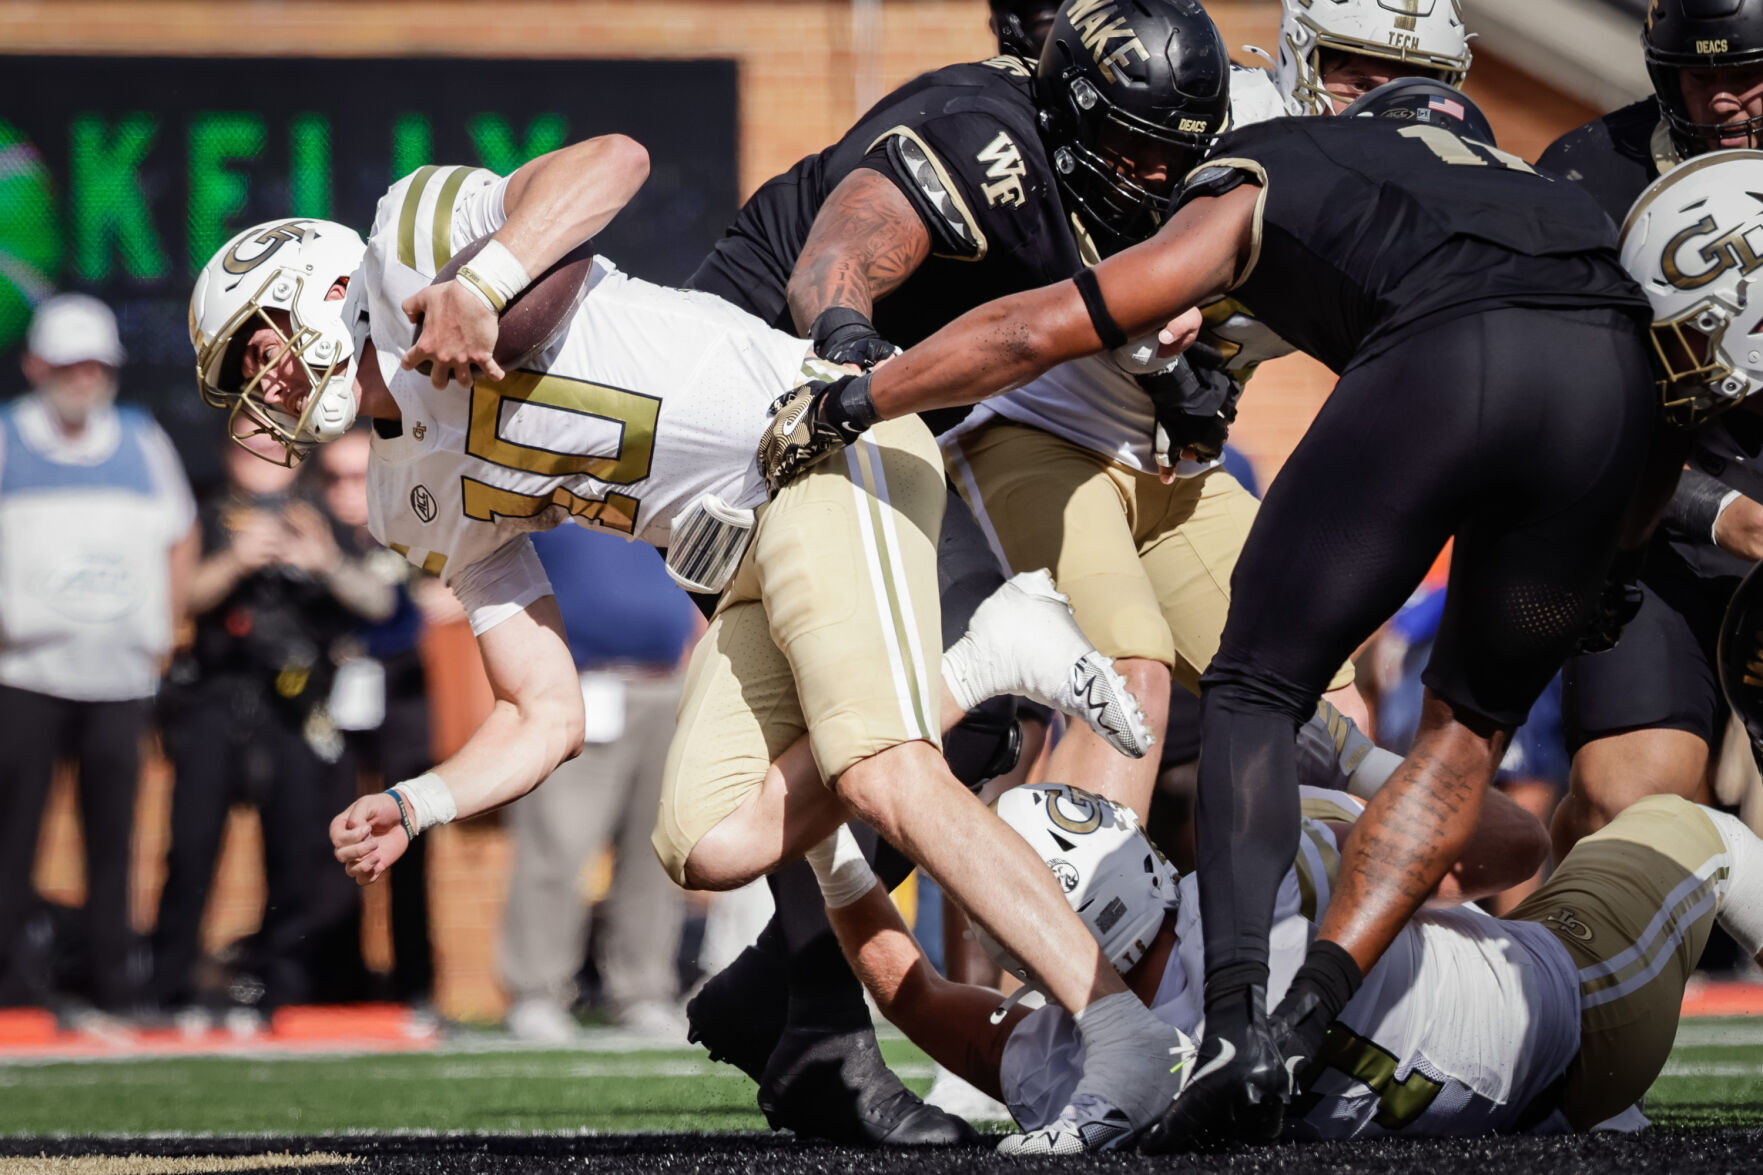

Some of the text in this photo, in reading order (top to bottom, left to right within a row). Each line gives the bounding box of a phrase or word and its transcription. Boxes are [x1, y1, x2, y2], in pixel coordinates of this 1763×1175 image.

[1388, 31, 1420, 50] TECH
[1695, 39, 1728, 54] DEACS
[1178, 118, 1208, 133] DEACS
[976, 131, 1027, 208] WF
[1660, 213, 1763, 291] GT
[461, 367, 663, 536] 10
